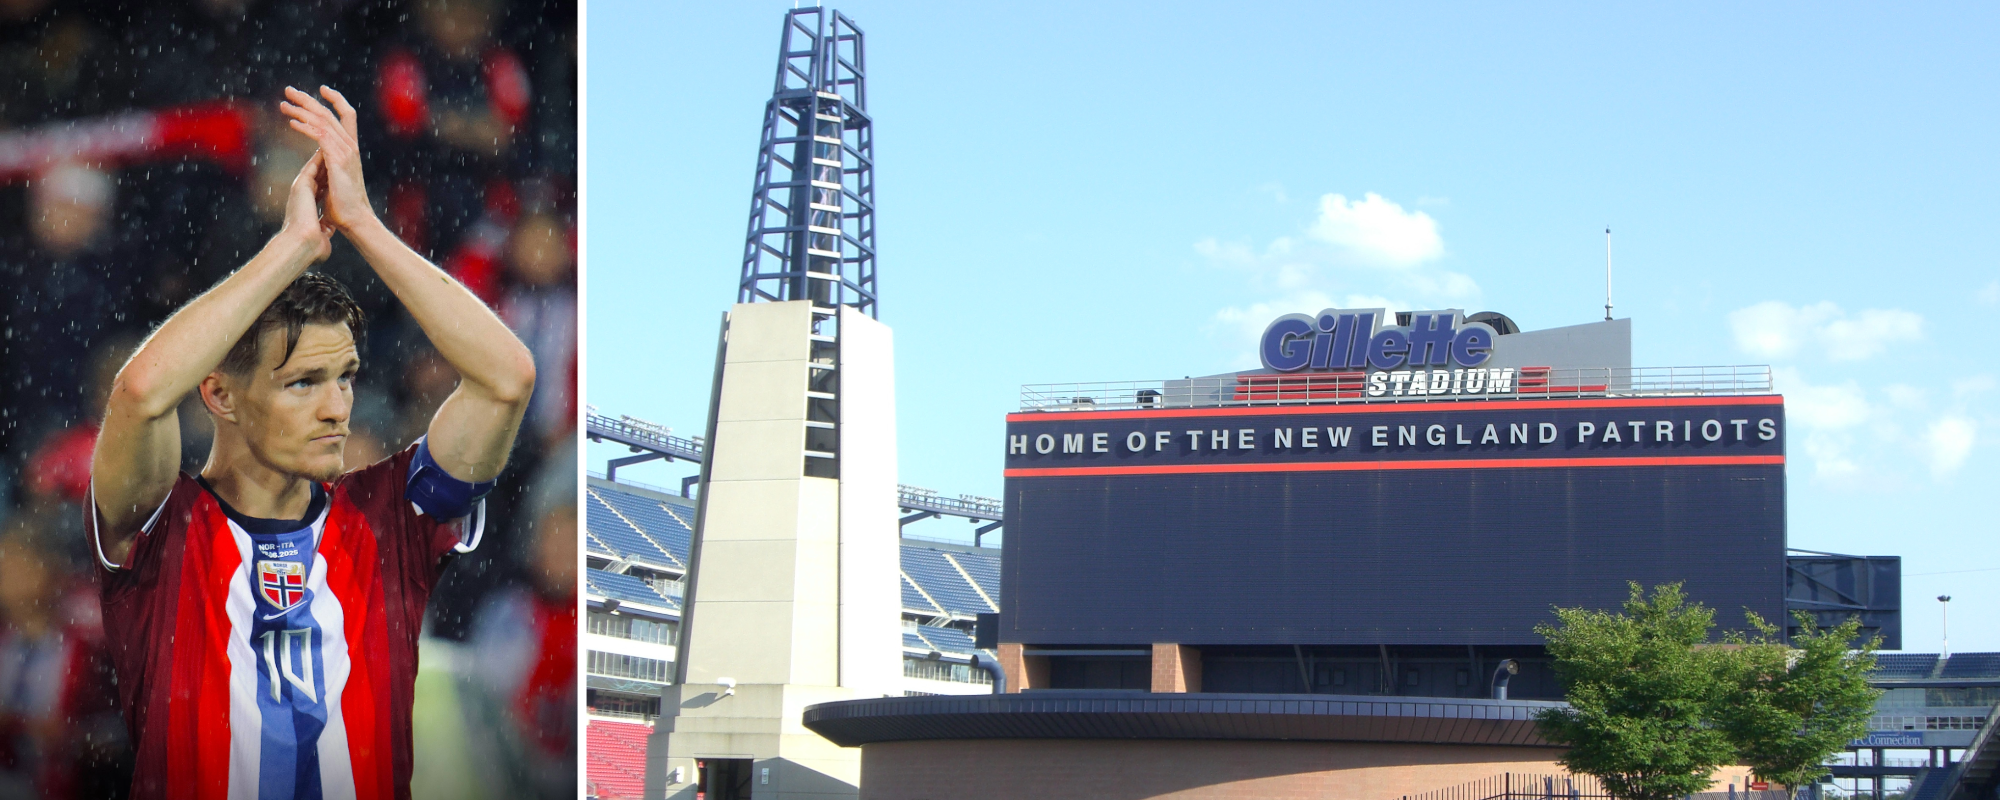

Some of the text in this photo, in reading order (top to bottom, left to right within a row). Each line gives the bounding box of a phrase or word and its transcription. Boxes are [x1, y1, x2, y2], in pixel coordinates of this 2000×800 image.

[1262, 312, 1494, 372] Gillette
[1368, 367, 1515, 397] STADIUM
[1009, 418, 1777, 455] HOME OF THE NEW ENGLAND PATRIOTS
[259, 626, 318, 705] 10
[1868, 734, 1920, 746] Connection
